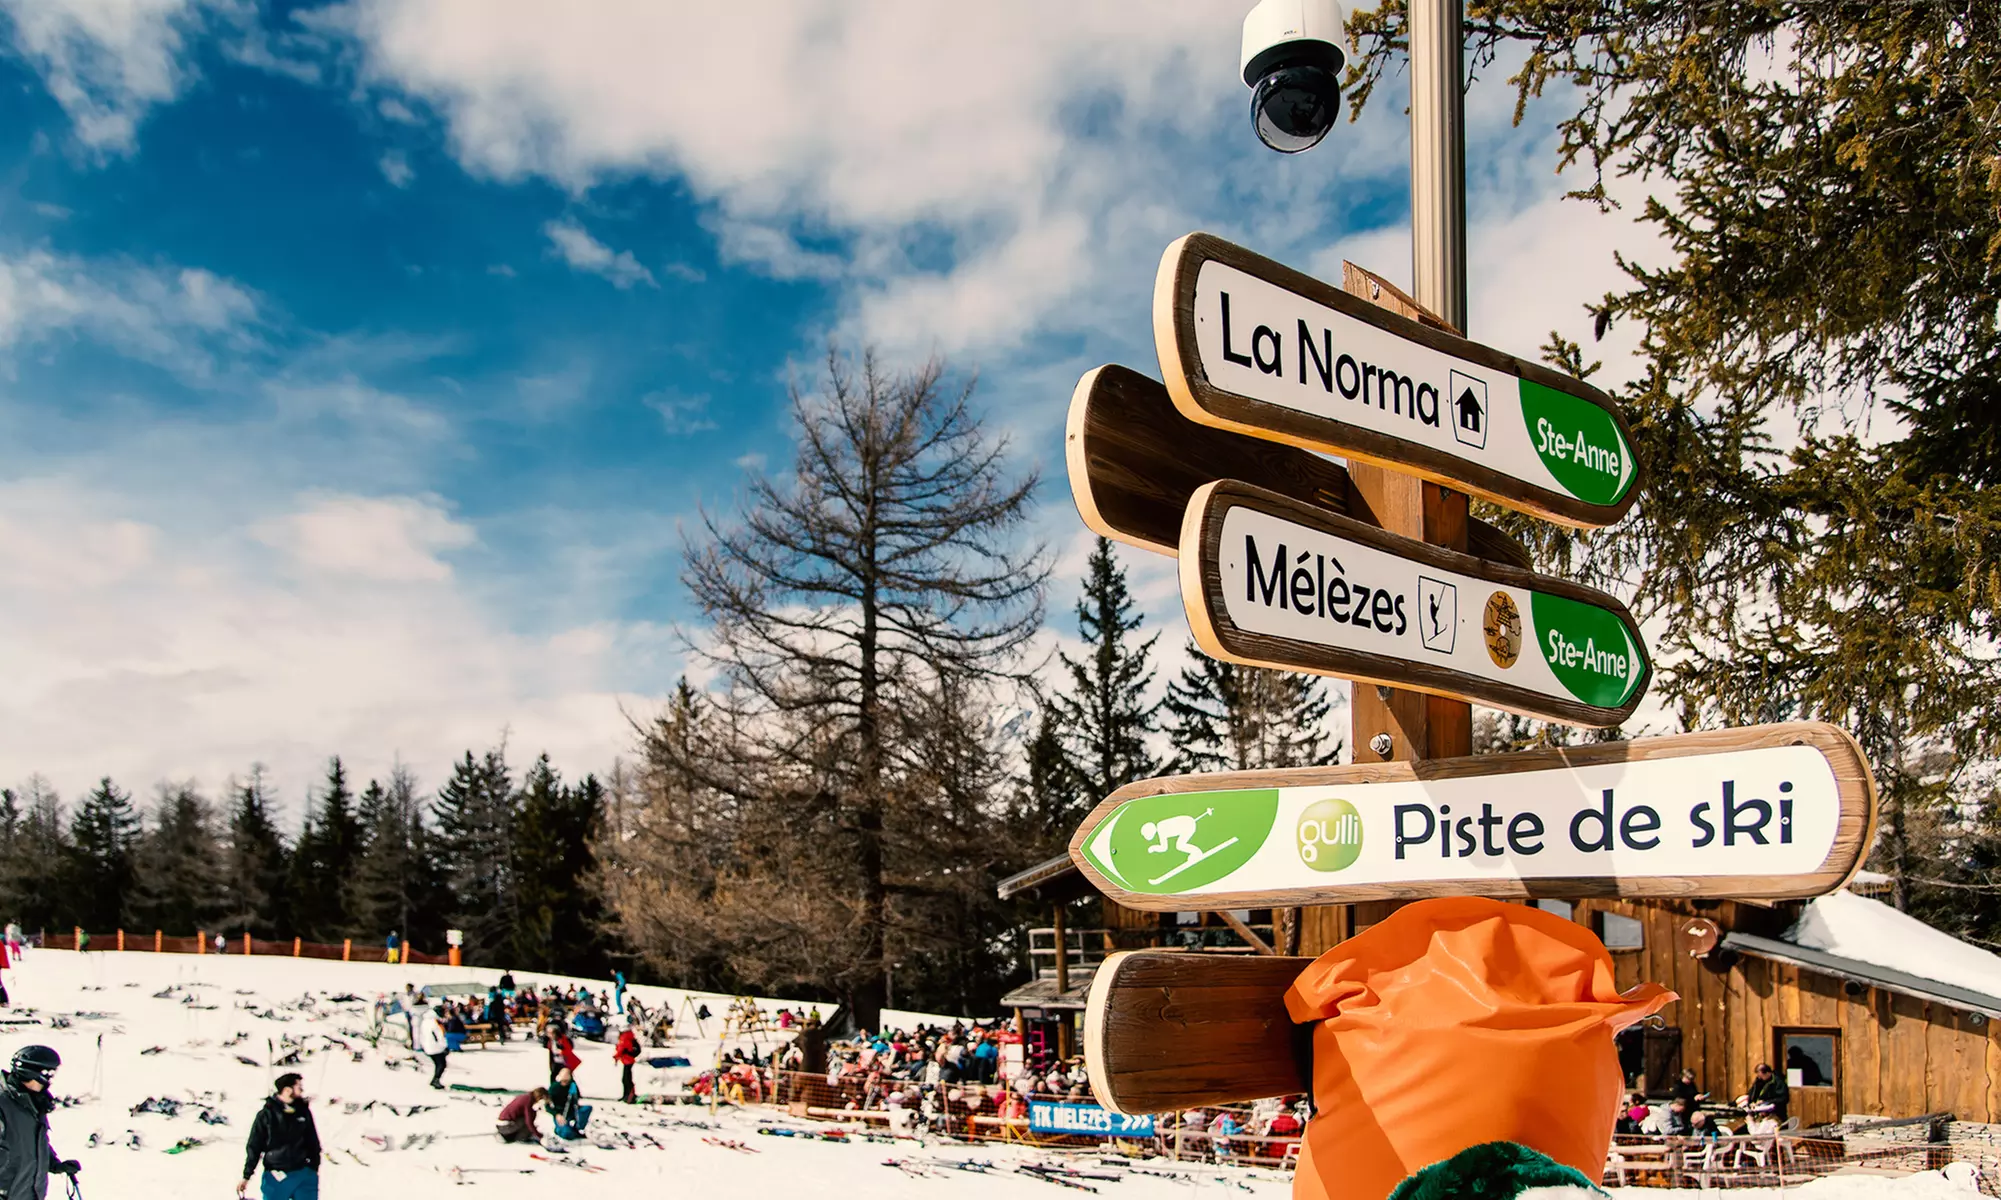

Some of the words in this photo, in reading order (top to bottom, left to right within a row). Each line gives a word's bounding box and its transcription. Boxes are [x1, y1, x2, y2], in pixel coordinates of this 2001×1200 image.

[1220, 290, 1283, 378] La
[1297, 318, 1440, 428] Norma
[1537, 417, 1619, 477] Ste-Anne
[1245, 534, 1407, 636] Mélèzes
[1548, 628, 1627, 679] Ste-Anne
[1299, 813, 1359, 863] gulli
[1393, 801, 1546, 860] Piste
[1569, 788, 1661, 853] de
[1690, 780, 1793, 848] ski
[1032, 1104, 1052, 1128] TK
